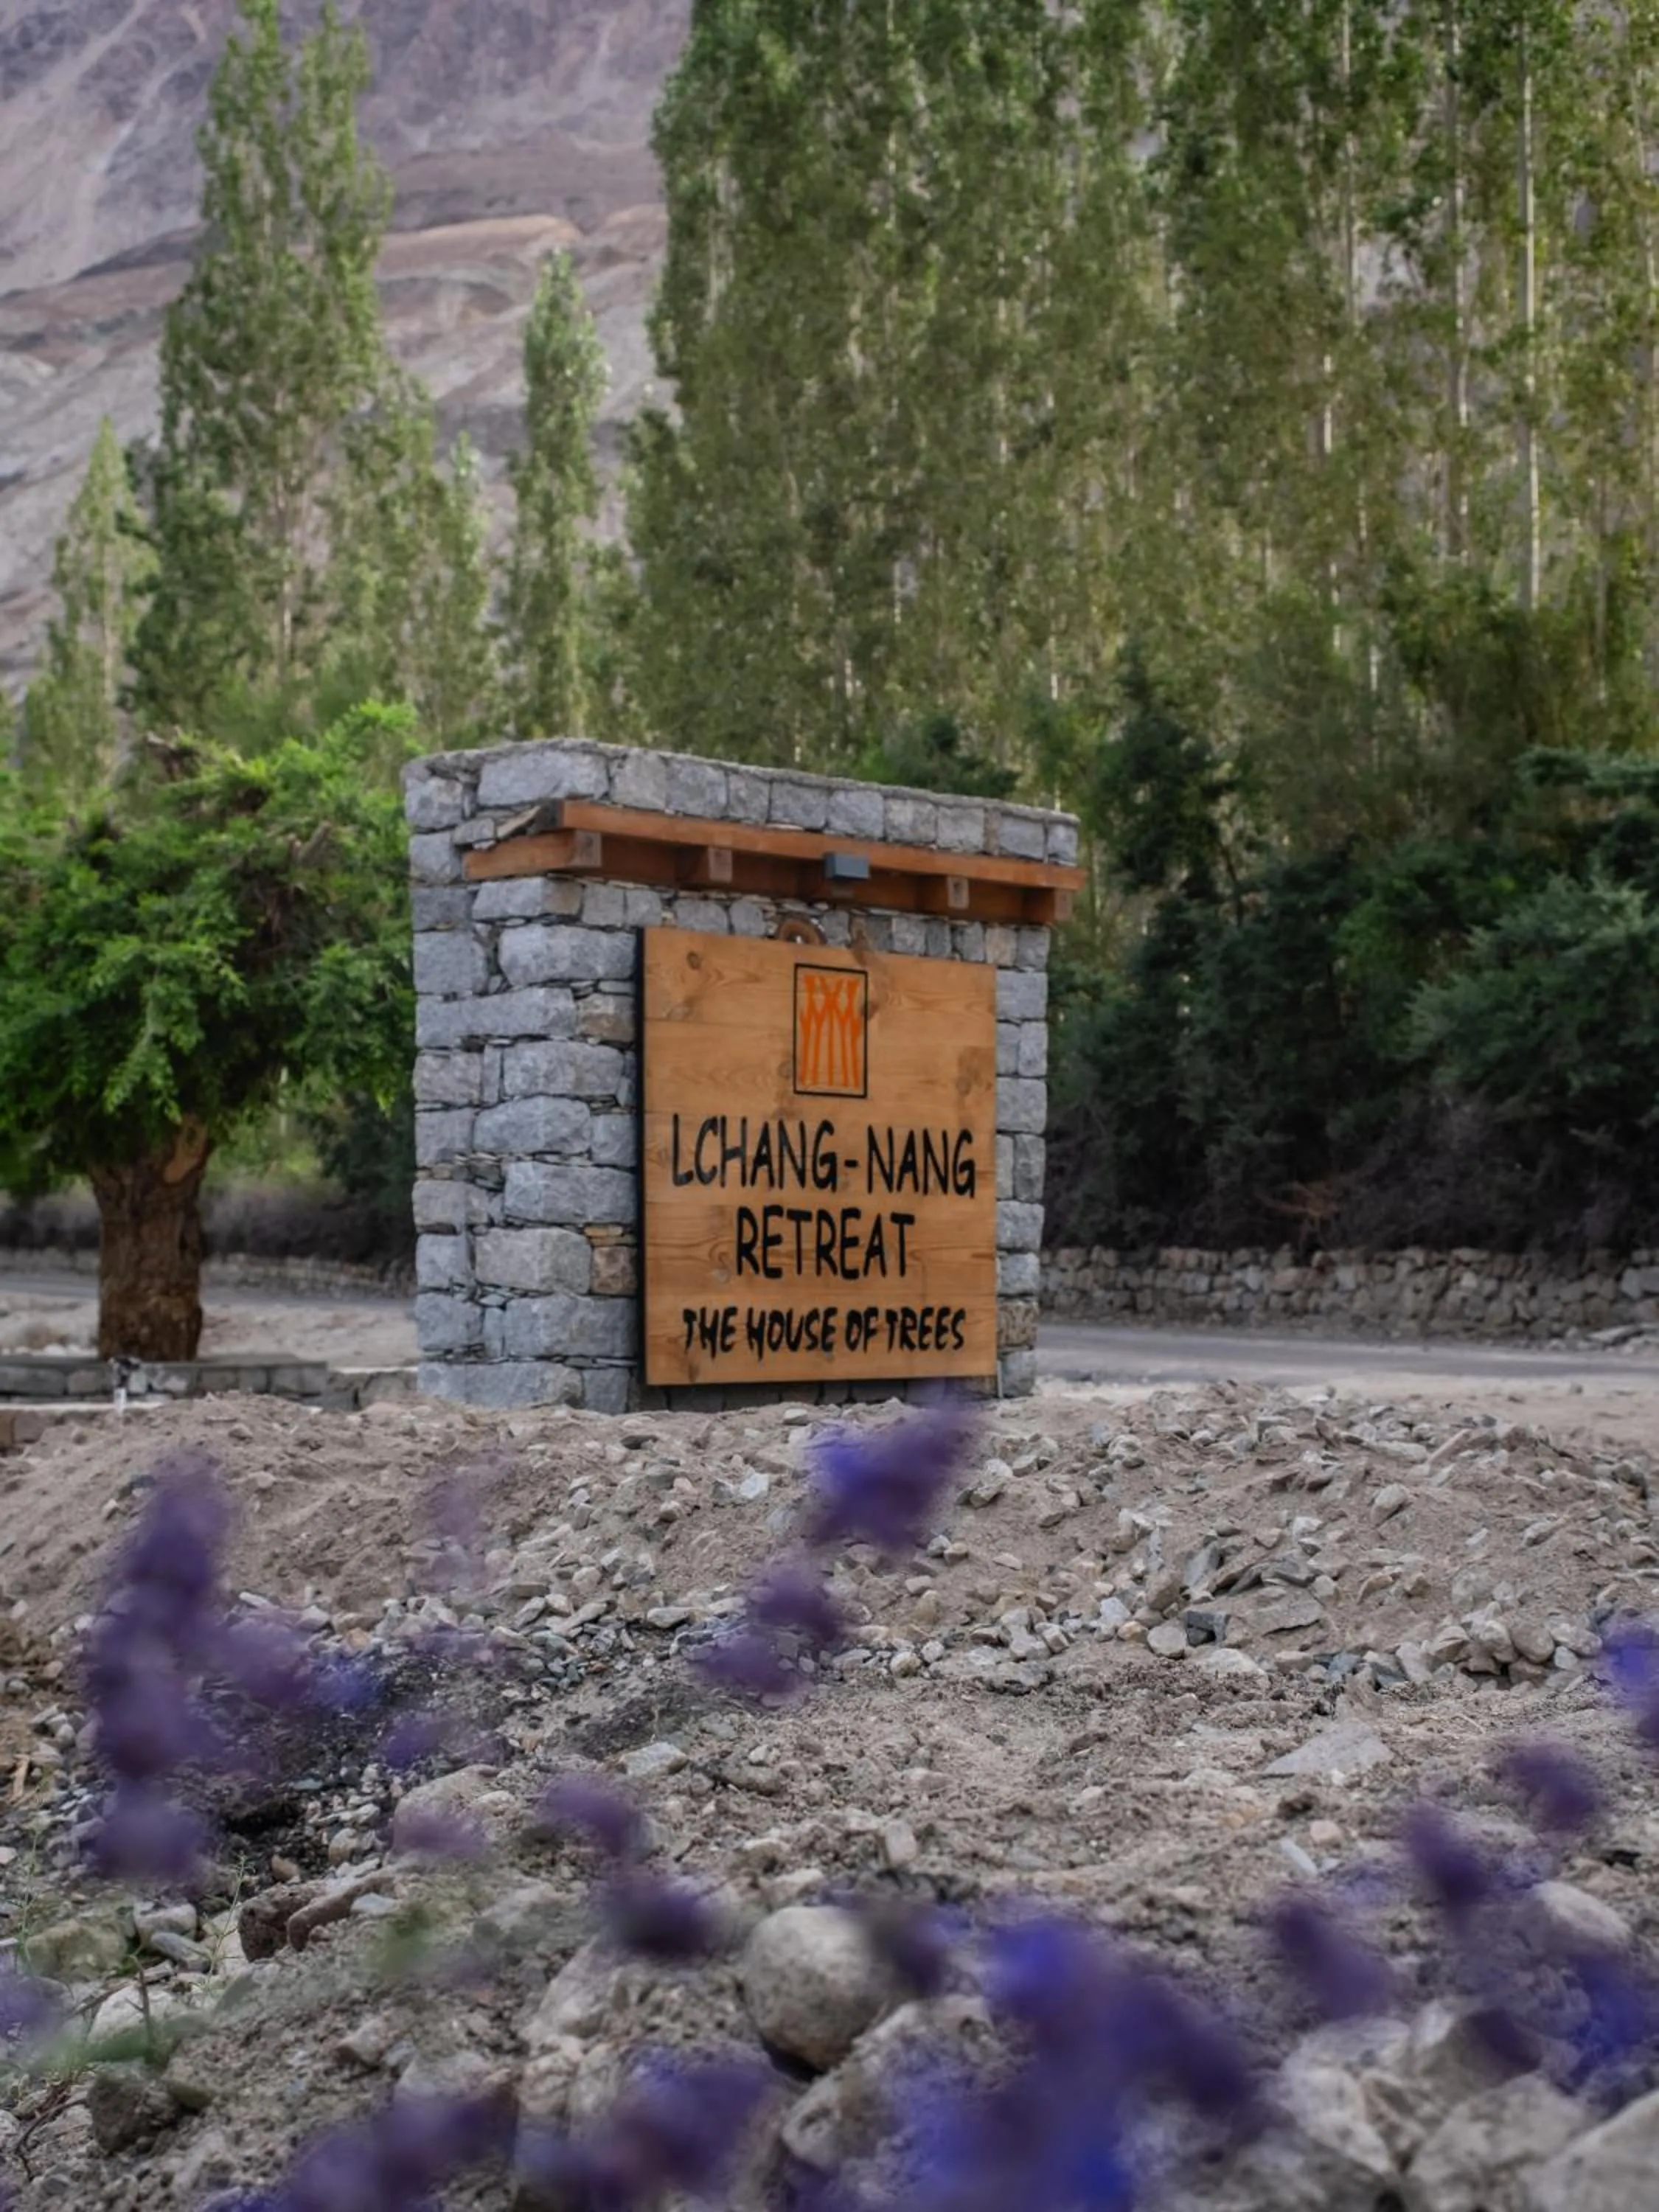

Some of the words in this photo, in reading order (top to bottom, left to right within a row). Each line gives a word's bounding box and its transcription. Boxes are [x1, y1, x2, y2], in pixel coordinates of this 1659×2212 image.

[672, 1113, 975, 1197] LCHANG-NANG
[736, 1205, 915, 1281] RETREAT
[684, 1307, 737, 1358] THE
[746, 1307, 838, 1360] HOUSE
[845, 1307, 879, 1352] OF
[885, 1307, 966, 1351] TREES
